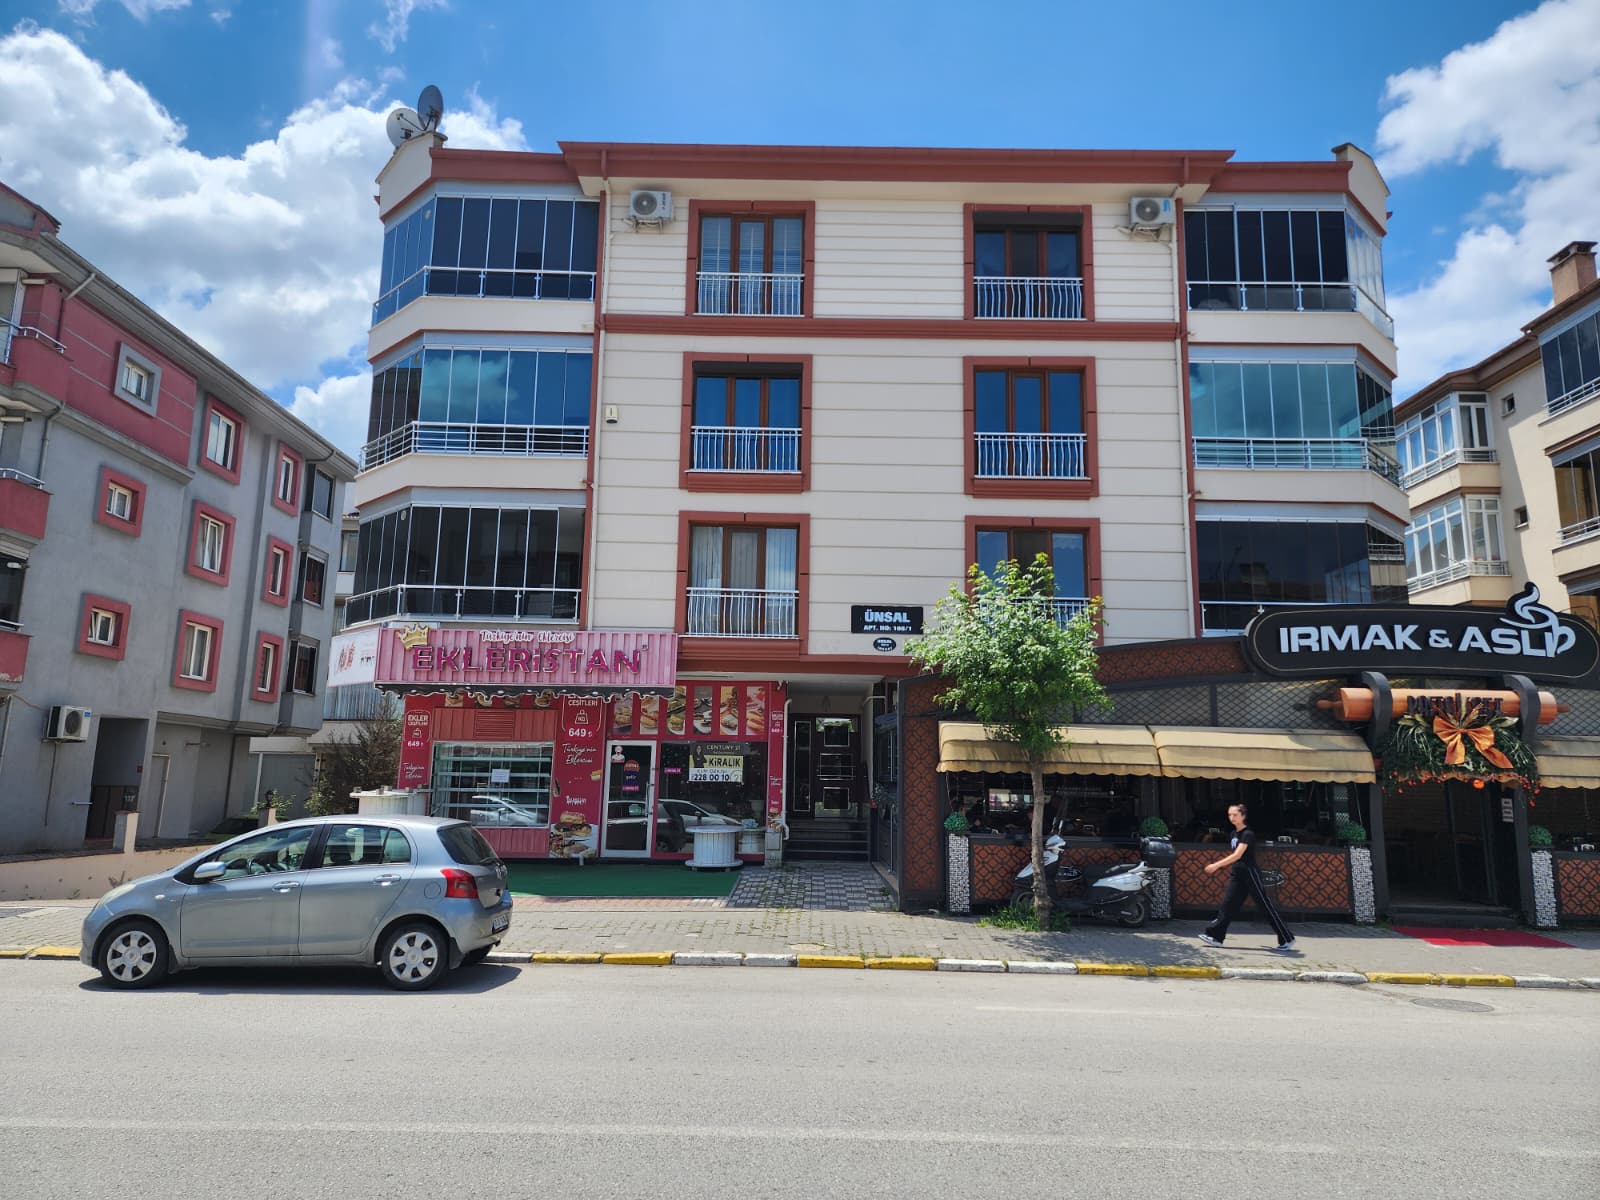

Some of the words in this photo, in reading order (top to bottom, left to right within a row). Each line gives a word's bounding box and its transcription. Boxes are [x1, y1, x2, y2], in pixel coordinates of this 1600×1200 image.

[864, 609, 911, 623] ÜNSAL
[1279, 624, 1422, 654] IRMAK
[1428, 629, 1453, 648] &
[568, 728, 587, 737] 649
[694, 773, 707, 781] 228
[709, 773, 720, 781] 00
[721, 773, 730, 781] 10
